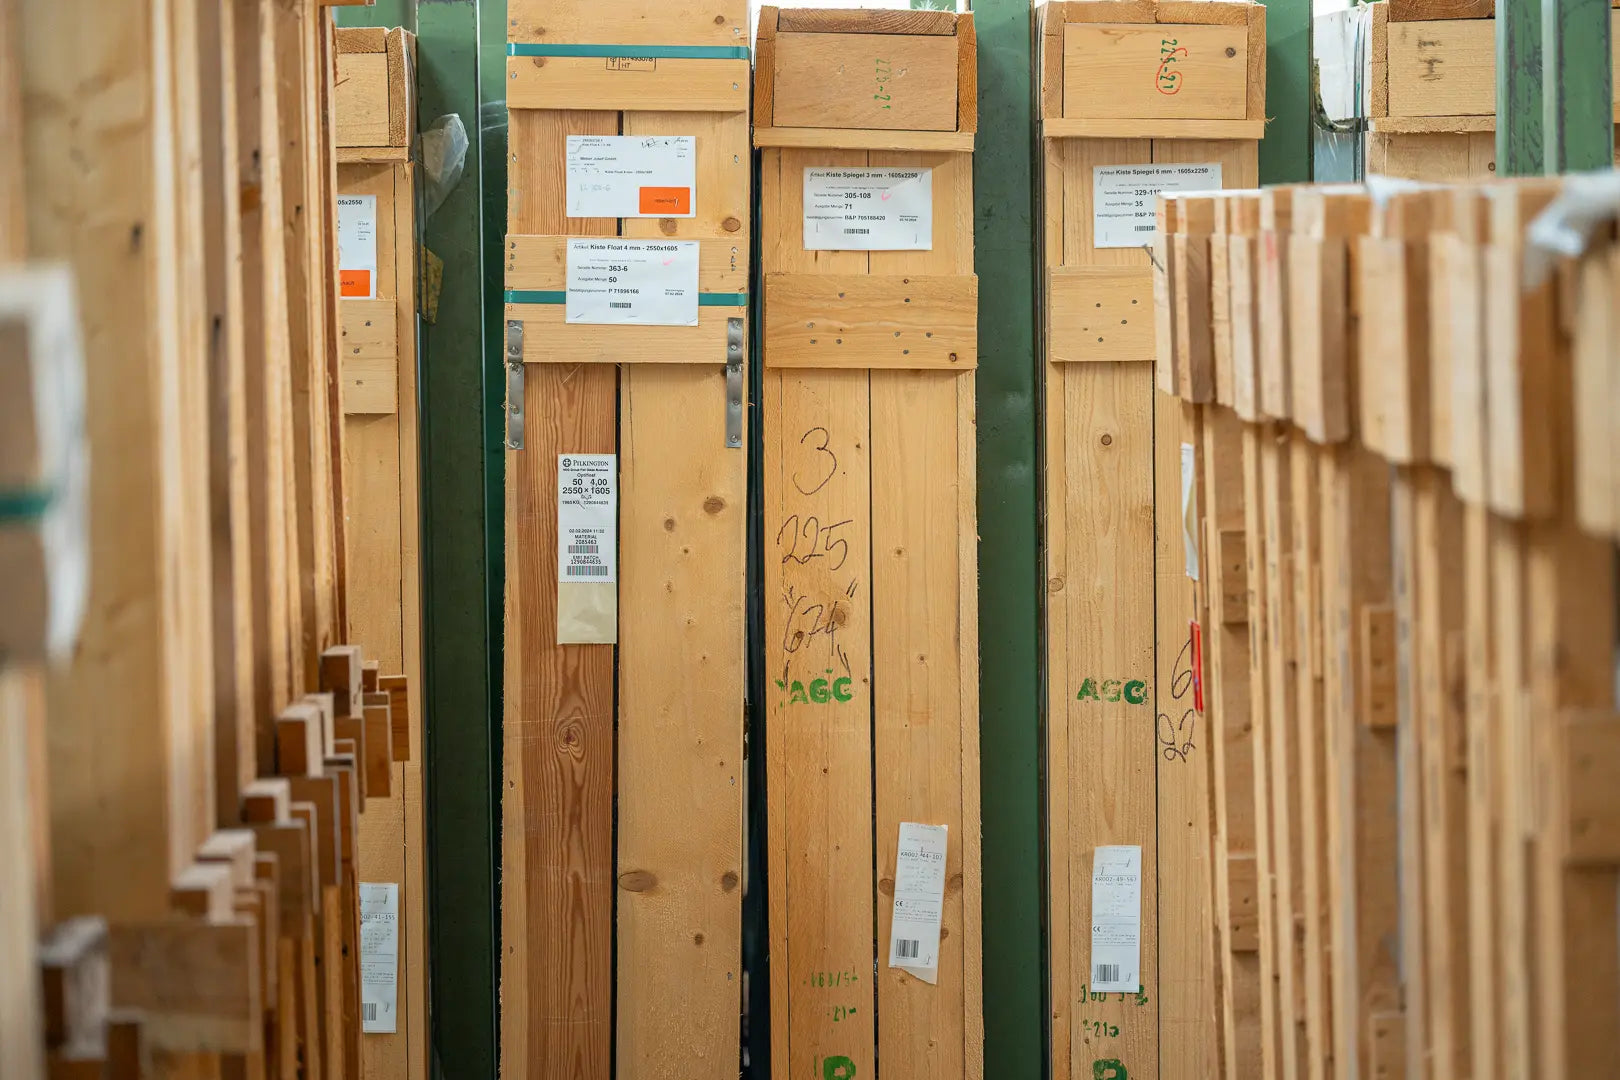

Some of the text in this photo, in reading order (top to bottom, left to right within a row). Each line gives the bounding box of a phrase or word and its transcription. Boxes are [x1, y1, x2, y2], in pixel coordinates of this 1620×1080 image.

[793, 426, 837, 496] 3
[562, 486, 583, 494] 2550
[591, 486, 611, 494] 1605
[572, 478, 608, 487] 50 4,00
[777, 514, 854, 571] 225
[789, 677, 853, 705] AGC
[1076, 678, 1146, 705] AGC
